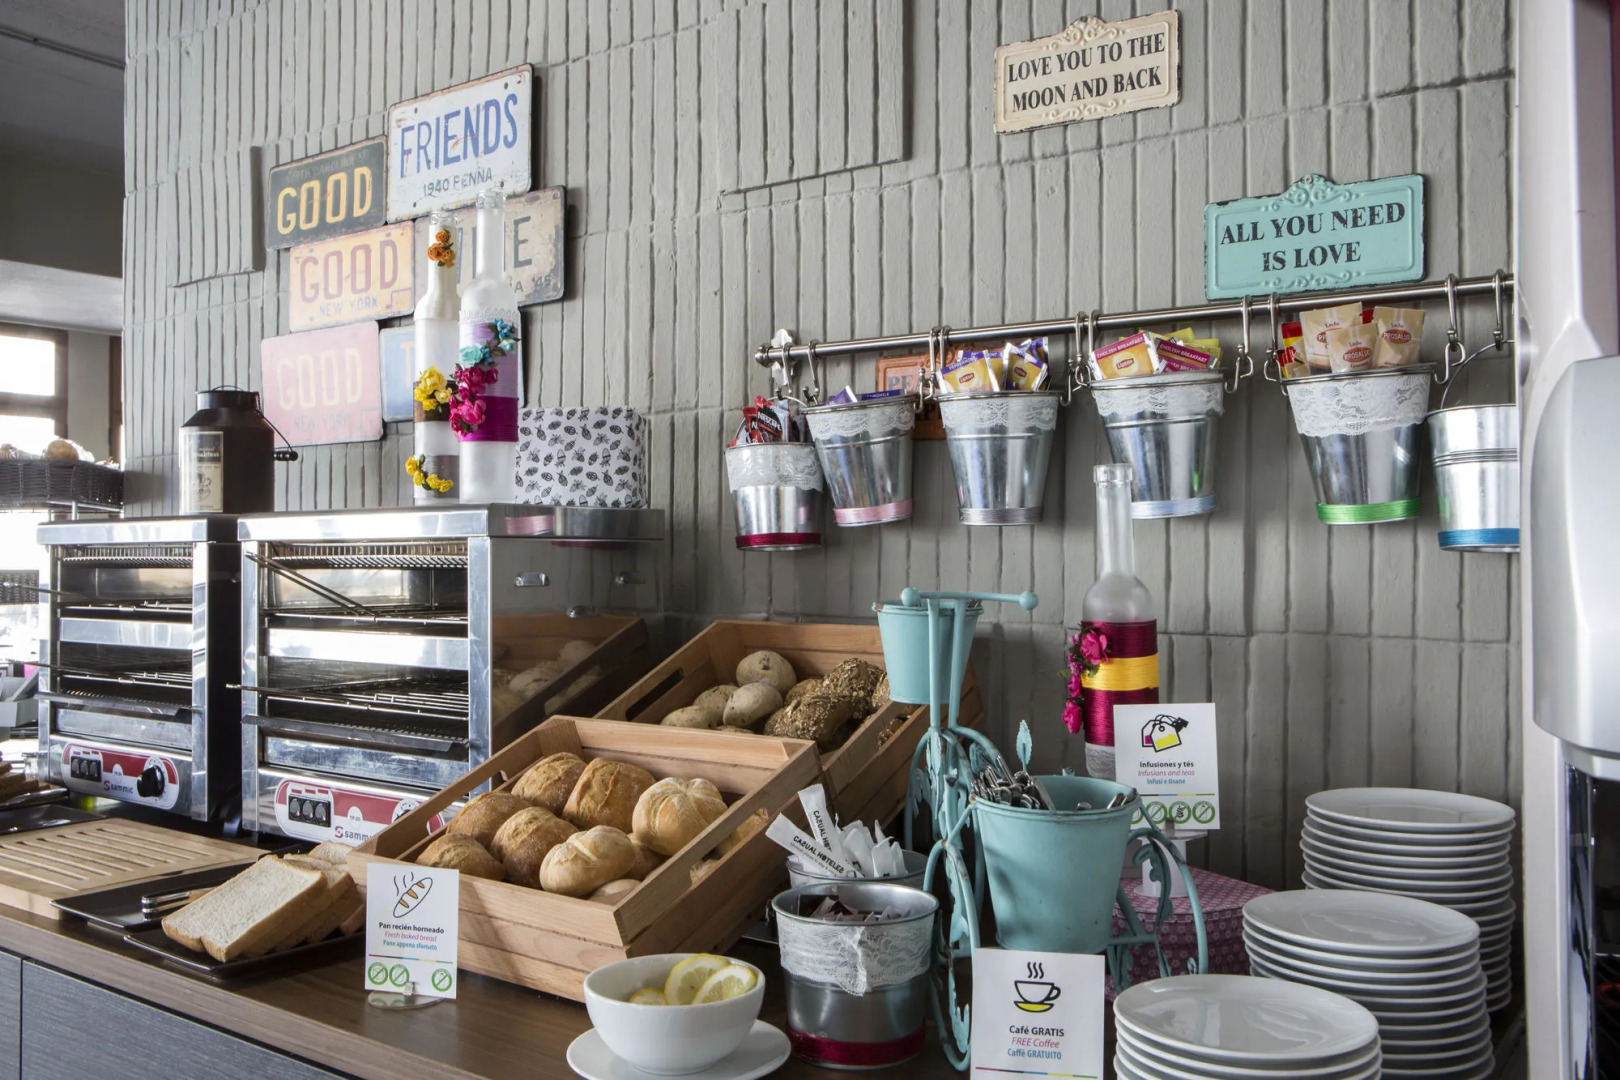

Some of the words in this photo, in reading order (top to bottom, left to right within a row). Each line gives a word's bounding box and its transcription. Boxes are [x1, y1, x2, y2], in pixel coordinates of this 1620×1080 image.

[1008, 56, 1051, 82] LOVE
[1056, 48, 1093, 72] YOU
[1098, 42, 1122, 64] TO
[1127, 32, 1165, 58] THE
[1013, 84, 1066, 112] MOON
[1071, 77, 1107, 102] AND
[1114, 66, 1161, 94] BACK
[400, 93, 518, 179] FRIENDS
[423, 178, 449, 197] 1940
[277, 166, 372, 235] GOOD
[1221, 221, 1265, 245] ALL
[1271, 213, 1323, 238] YOU
[1331, 202, 1405, 231] NEED
[1262, 250, 1286, 272] IS
[1294, 241, 1361, 269] LOVE
[300, 239, 398, 303] GOOD
[319, 302, 342, 316] NEW
[349, 294, 379, 310] YORK
[1097, 347, 1118, 358] ENGLISH
[1117, 337, 1144, 351] BREAKFAST
[1160, 344, 1180, 355] ENGLISH
[1181, 350, 1208, 363] BREAKFAST
[276, 347, 362, 411] GOOD
[294, 415, 315, 430] NEW
[321, 411, 349, 427] YORK
[813, 810, 826, 837] CASUAL
[793, 835, 816, 855] CASUAL
[817, 851, 845, 874] HOTELES
[379, 921, 391, 929] Pan
[413, 925, 445, 934] horneado
[384, 931, 400, 939] Fresh
[401, 932, 420, 941] baked
[420, 934, 438, 942] bread
[1009, 1025, 1030, 1035] Café
[1031, 1027, 1065, 1037] GRATIS
[1011, 1037, 1032, 1047] FREE
[1033, 1038, 1061, 1049] Coffee
[1027, 1049, 1062, 1060] GRATUITO
